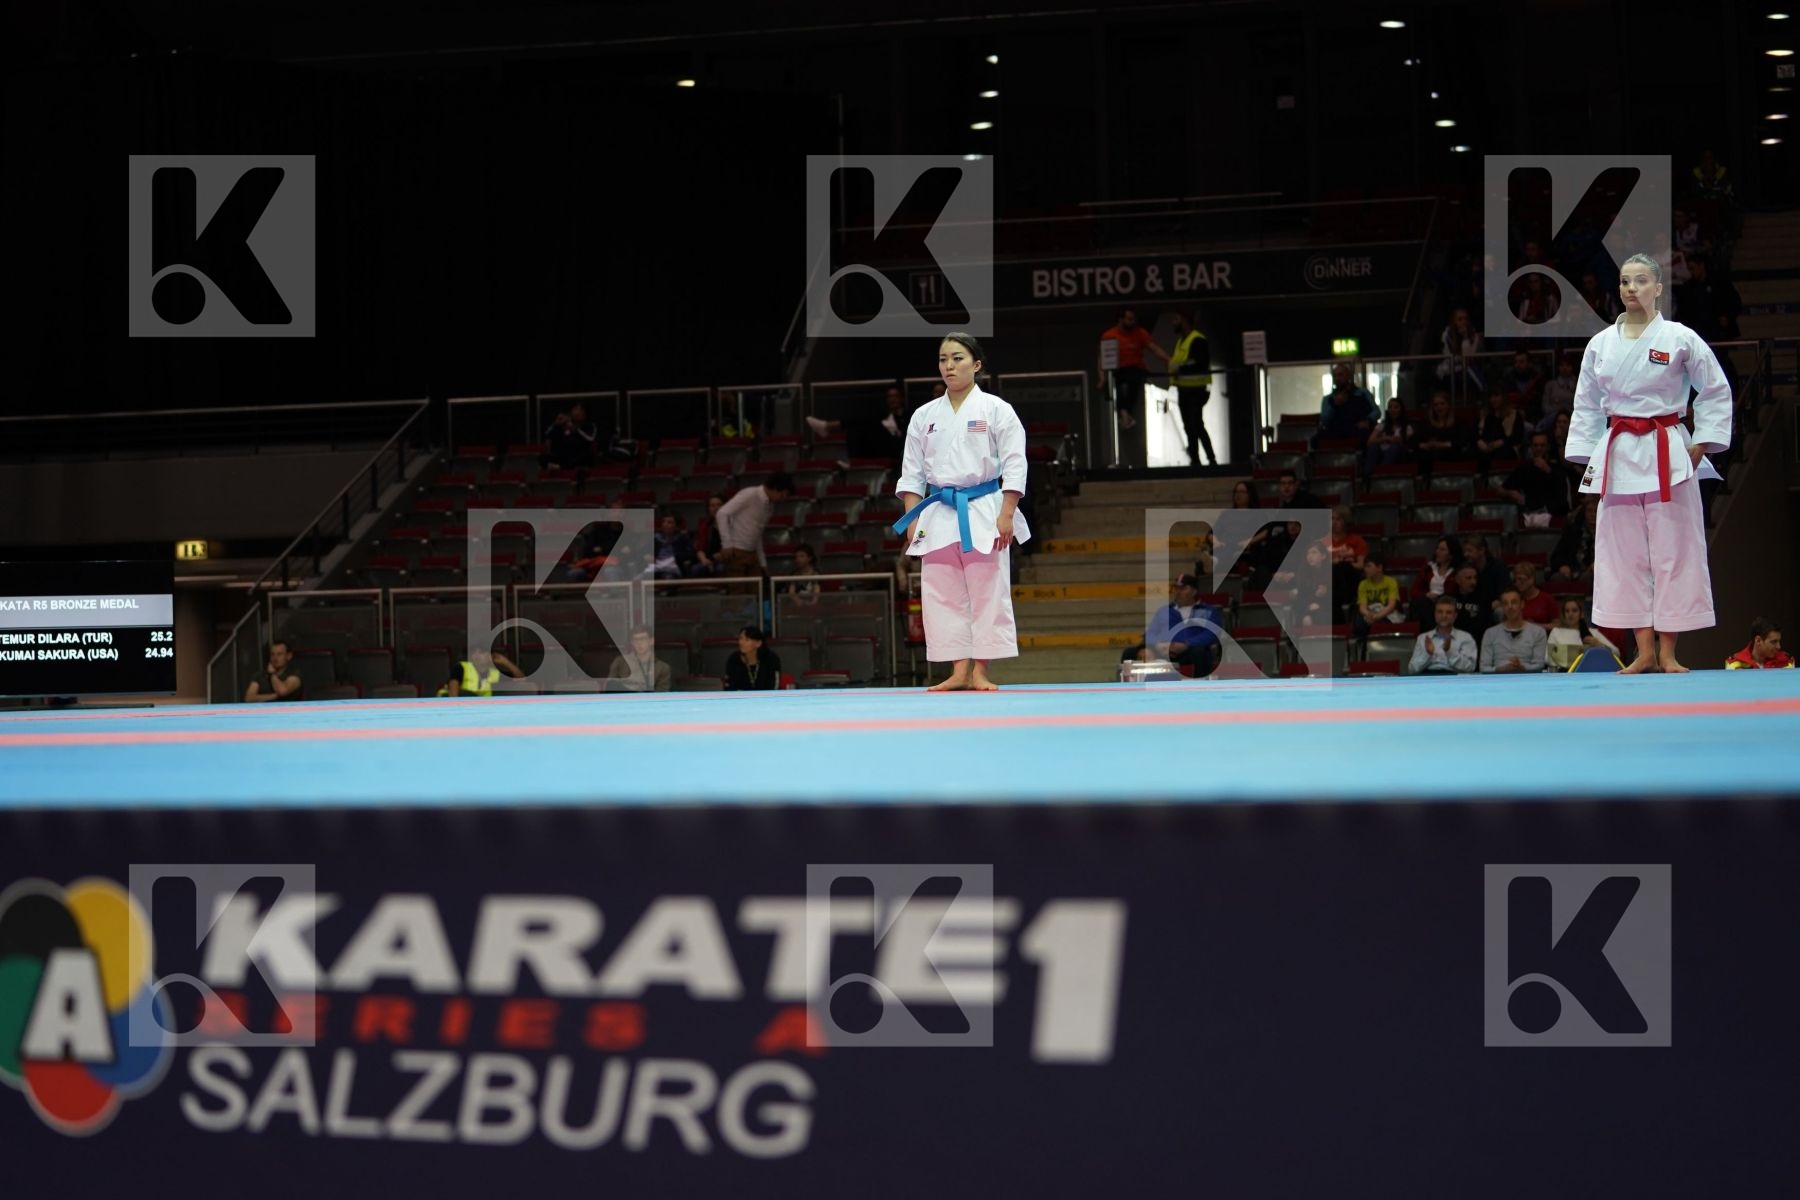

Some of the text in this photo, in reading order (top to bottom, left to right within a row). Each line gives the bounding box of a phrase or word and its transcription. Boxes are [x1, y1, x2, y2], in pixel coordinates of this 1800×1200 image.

[1032, 261, 1232, 298] BISTRO & BAR
[1092, 540, 1098, 550] 1
[1033, 587, 1067, 598] Block 1
[0, 598, 139, 611] KATA R5 BRONZE MEDAL
[38, 632, 80, 644] DILARA
[82, 632, 113, 645] (TUR)
[151, 631, 173, 642] 25.2
[0, 648, 118, 661] KUMAI SAKURA (USA)
[145, 647, 173, 658] 24.94
[196, 990, 829, 1058] SERIES A
[179, 1041, 818, 1160] SALZBURG
